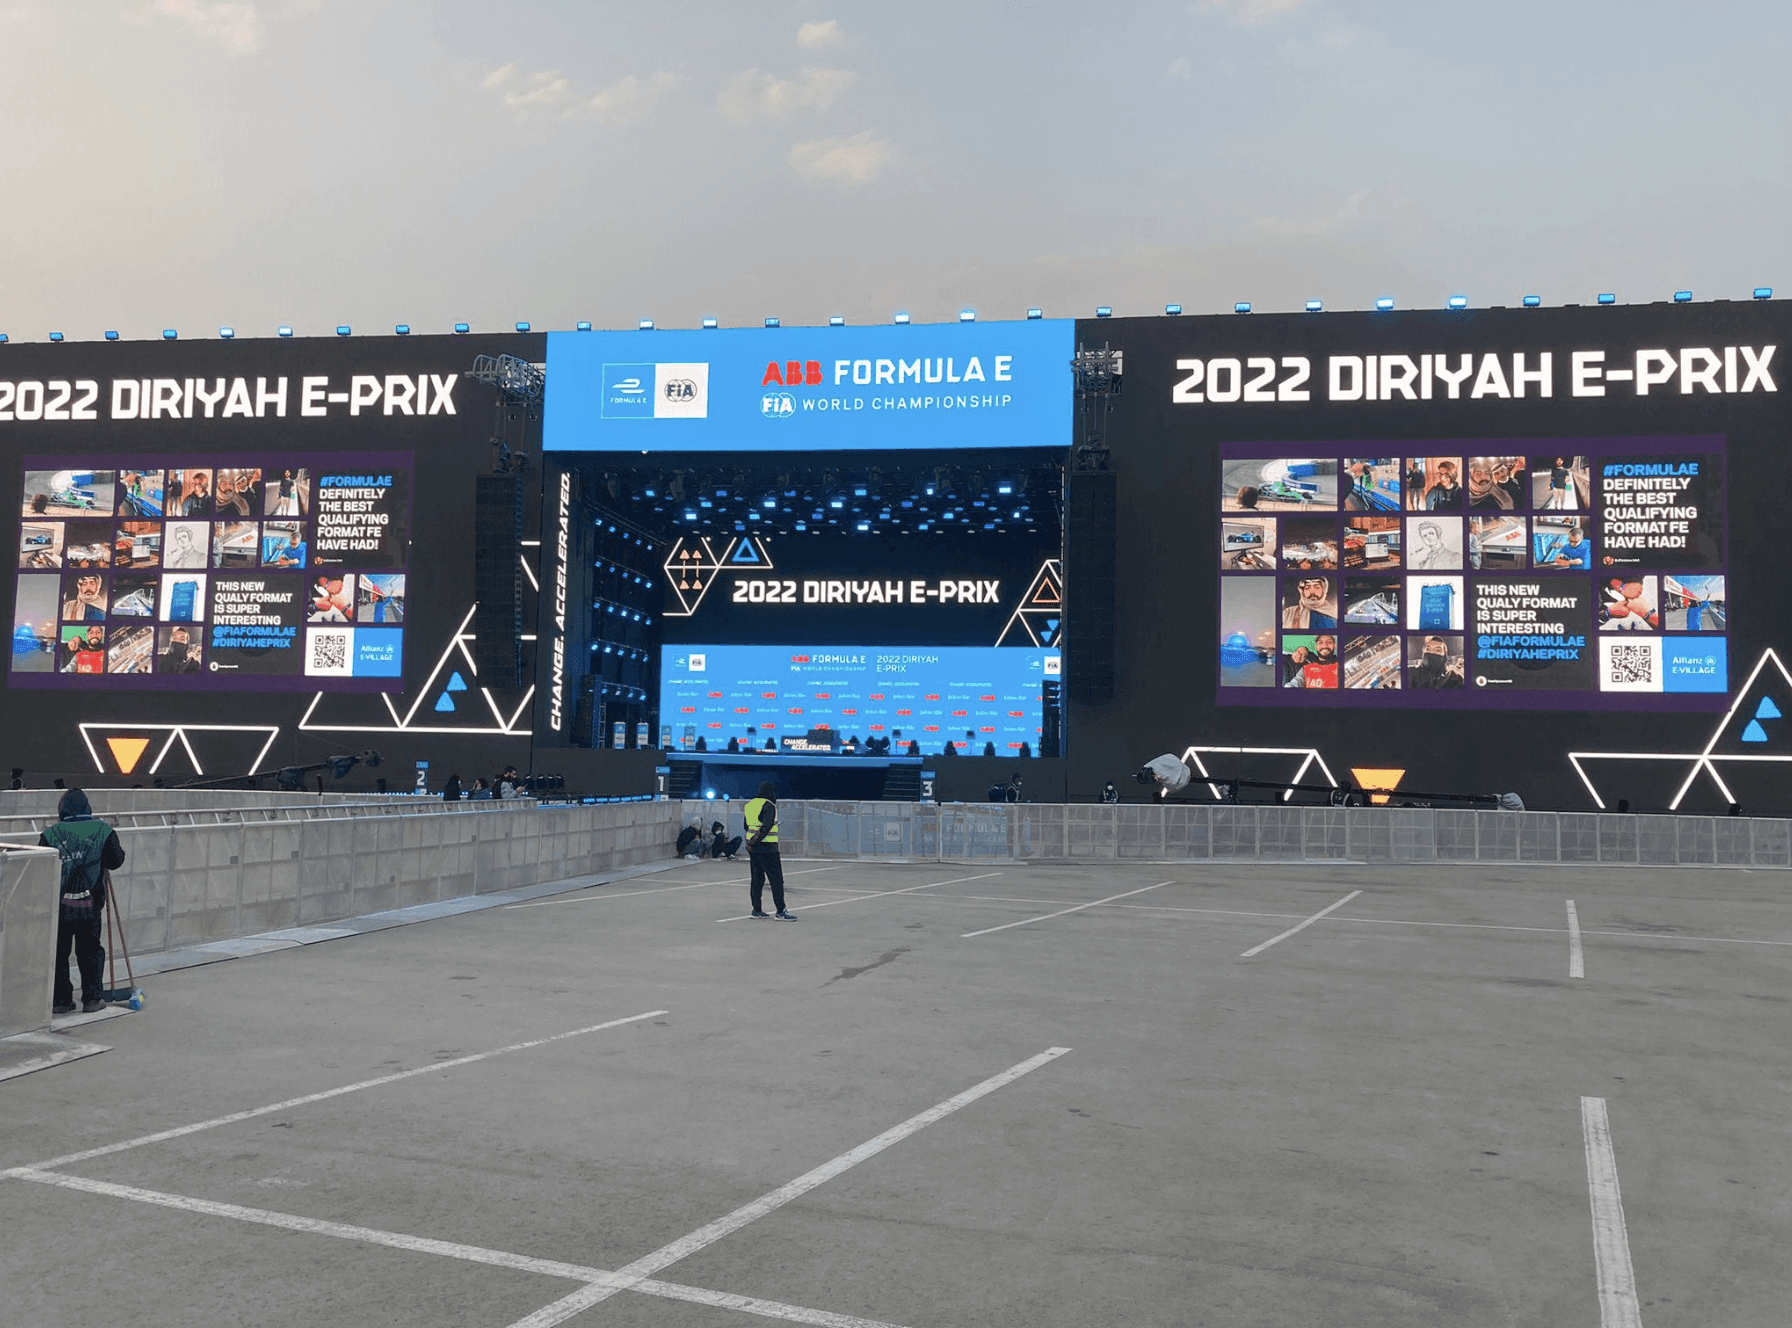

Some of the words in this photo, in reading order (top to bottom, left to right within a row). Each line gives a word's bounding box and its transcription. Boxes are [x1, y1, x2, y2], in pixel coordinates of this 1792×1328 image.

[762, 361, 823, 386] ABB
[835, 358, 985, 385] FORMULA
[995, 356, 1013, 381] E
[1172, 356, 1311, 404] 2022
[1328, 351, 1553, 401] DIRIYAH
[1571, 345, 1778, 397] E-PRIX
[0, 379, 99, 421] 2022
[111, 376, 288, 420] DIRIYAH
[300, 373, 459, 417] E-PRIX
[610, 397, 642, 405] FORMULA
[802, 398, 864, 411] WORLD
[872, 394, 1012, 410] CHAMPIONSHIP
[1603, 462, 1699, 477] #FORMULAE
[320, 475, 392, 487] #FORMULAE
[1603, 477, 1692, 491] DEFINITELY
[319, 488, 386, 500] DEFINITELY
[1603, 492, 1634, 506] THE
[1636, 491, 1677, 505] BEST
[318, 501, 342, 512] THE
[343, 501, 375, 512] BEST
[317, 513, 389, 526] QUALIFYING
[1604, 506, 1698, 521] QUALIFYING
[317, 526, 366, 537] FORMAT
[366, 526, 382, 537] FE
[1604, 522, 1666, 535] FORMAT
[1669, 521, 1689, 534] FE
[316, 539, 348, 550] HAVE
[349, 539, 379, 550] HAD!
[1604, 536, 1646, 549] HAVE
[1648, 535, 1686, 549] HAD!
[556, 472, 570, 632] ACCELERATED.
[215, 581, 239, 592] THIS
[240, 581, 265, 592] NEW
[733, 580, 797, 603] 2022
[803, 580, 904, 603] DIRIYAH
[910, 579, 1000, 603] E-PRIX
[1476, 584, 1508, 596] THIS
[1508, 584, 1540, 596] NEW
[214, 592, 250, 604] QUALY
[249, 592, 293, 603] FORMAT
[1476, 598, 1523, 610] QUALY
[1522, 597, 1578, 609] FORMAT
[214, 603, 225, 614] IS
[225, 603, 261, 614] SUPER
[213, 615, 282, 626] INTERESTING
[1476, 610, 1491, 621] IS
[1492, 610, 1537, 622] SUPER
[212, 626, 297, 638] @FIAFORMULAE
[1476, 622, 1565, 635] INTERESTING
[211, 637, 291, 648] #DIRIYAHEPRIX
[1477, 635, 1586, 648] @FIAFORMULAE
[812, 654, 859, 664] FORMULA
[860, 654, 867, 664] E
[876, 654, 901, 664] 2022
[902, 654, 940, 664] DIRIYAH
[1477, 648, 1580, 660] #DIRIYAHEPRIX
[1672, 656, 1704, 665] Allianz
[876, 664, 907, 673] E-PRIX
[550, 635, 564, 731] CHANGE.
[416, 770, 426, 787] 2
[657, 776, 665, 792] 1
[922, 780, 933, 797] 3
